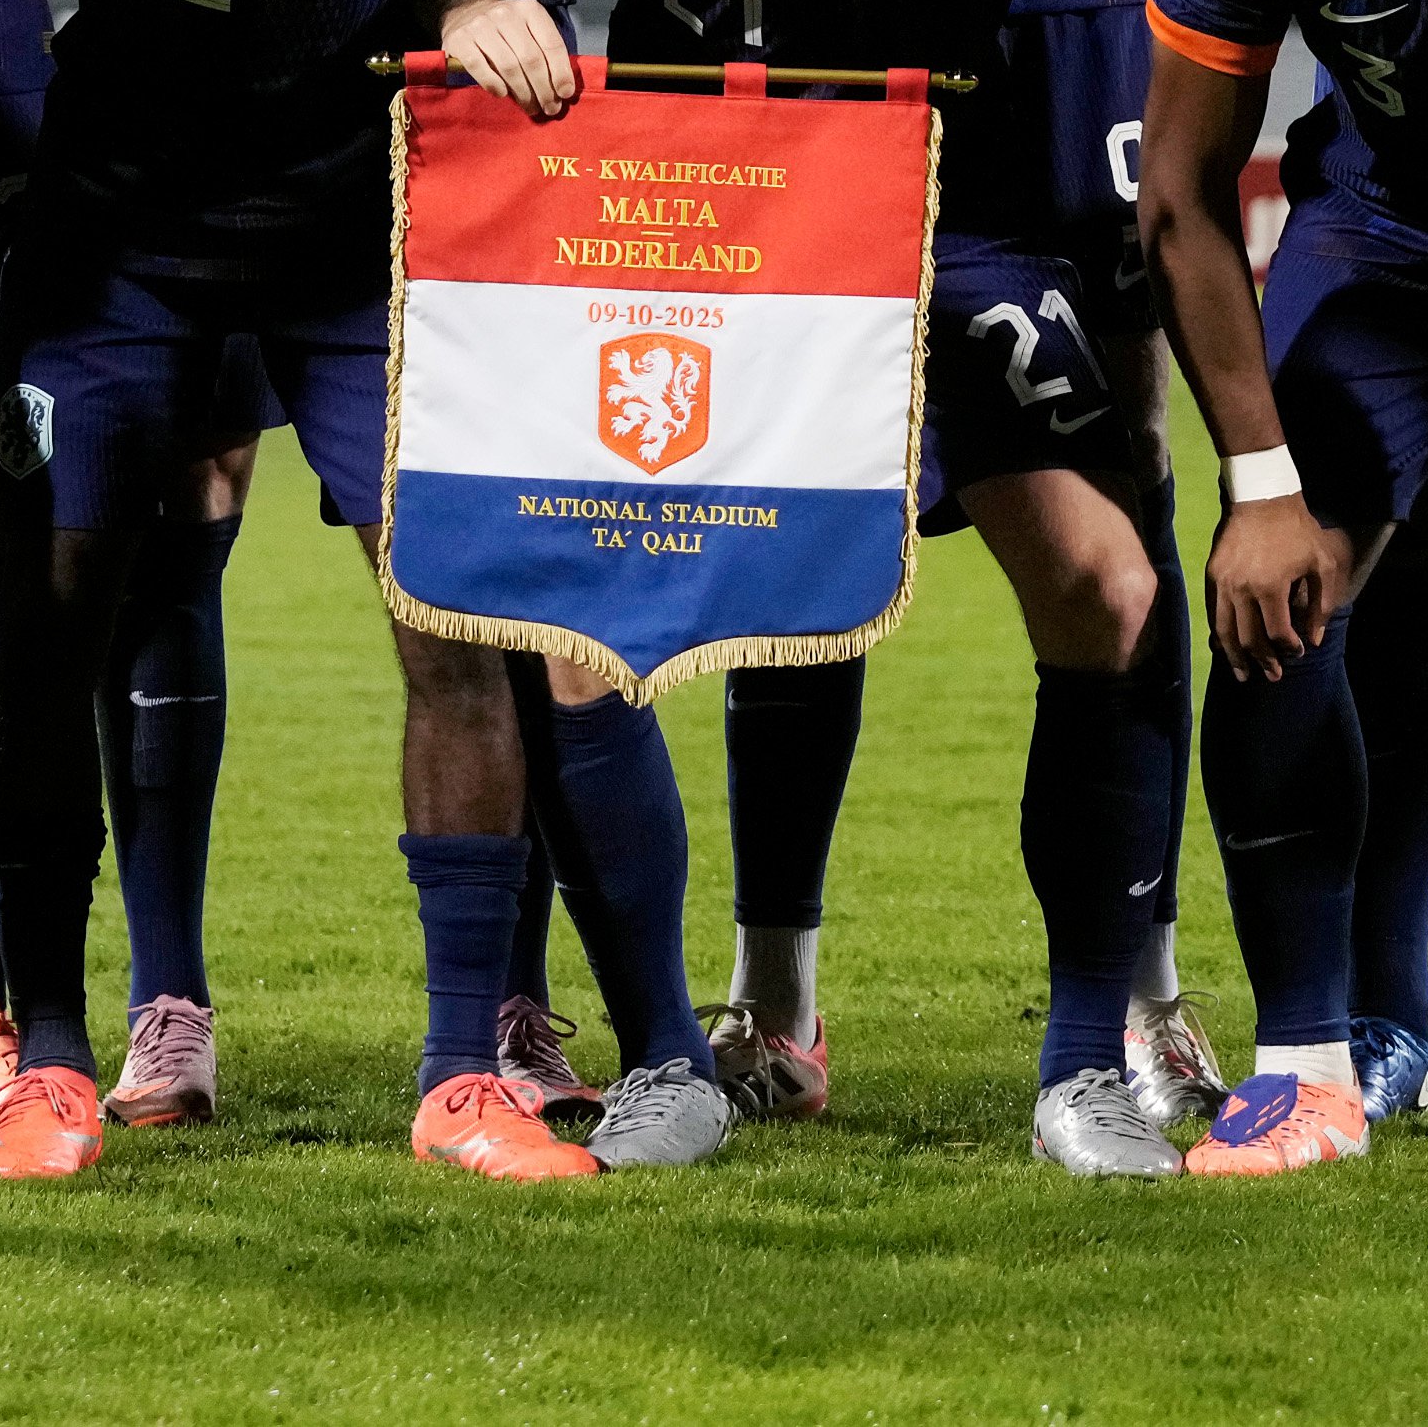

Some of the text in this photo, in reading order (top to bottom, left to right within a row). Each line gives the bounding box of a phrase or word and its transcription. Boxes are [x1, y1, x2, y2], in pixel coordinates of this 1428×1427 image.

[1341, 41, 1406, 118] 3
[538, 155, 580, 177] WK
[599, 159, 787, 188] KWALIFICATIE
[599, 195, 719, 228] MALTA
[554, 237, 762, 273] NEDERLAND
[588, 301, 725, 329] 09-10-2025
[966, 289, 1109, 407] 21
[518, 495, 779, 528] NATIONAL STADIUM
[642, 531, 703, 556] QALI
